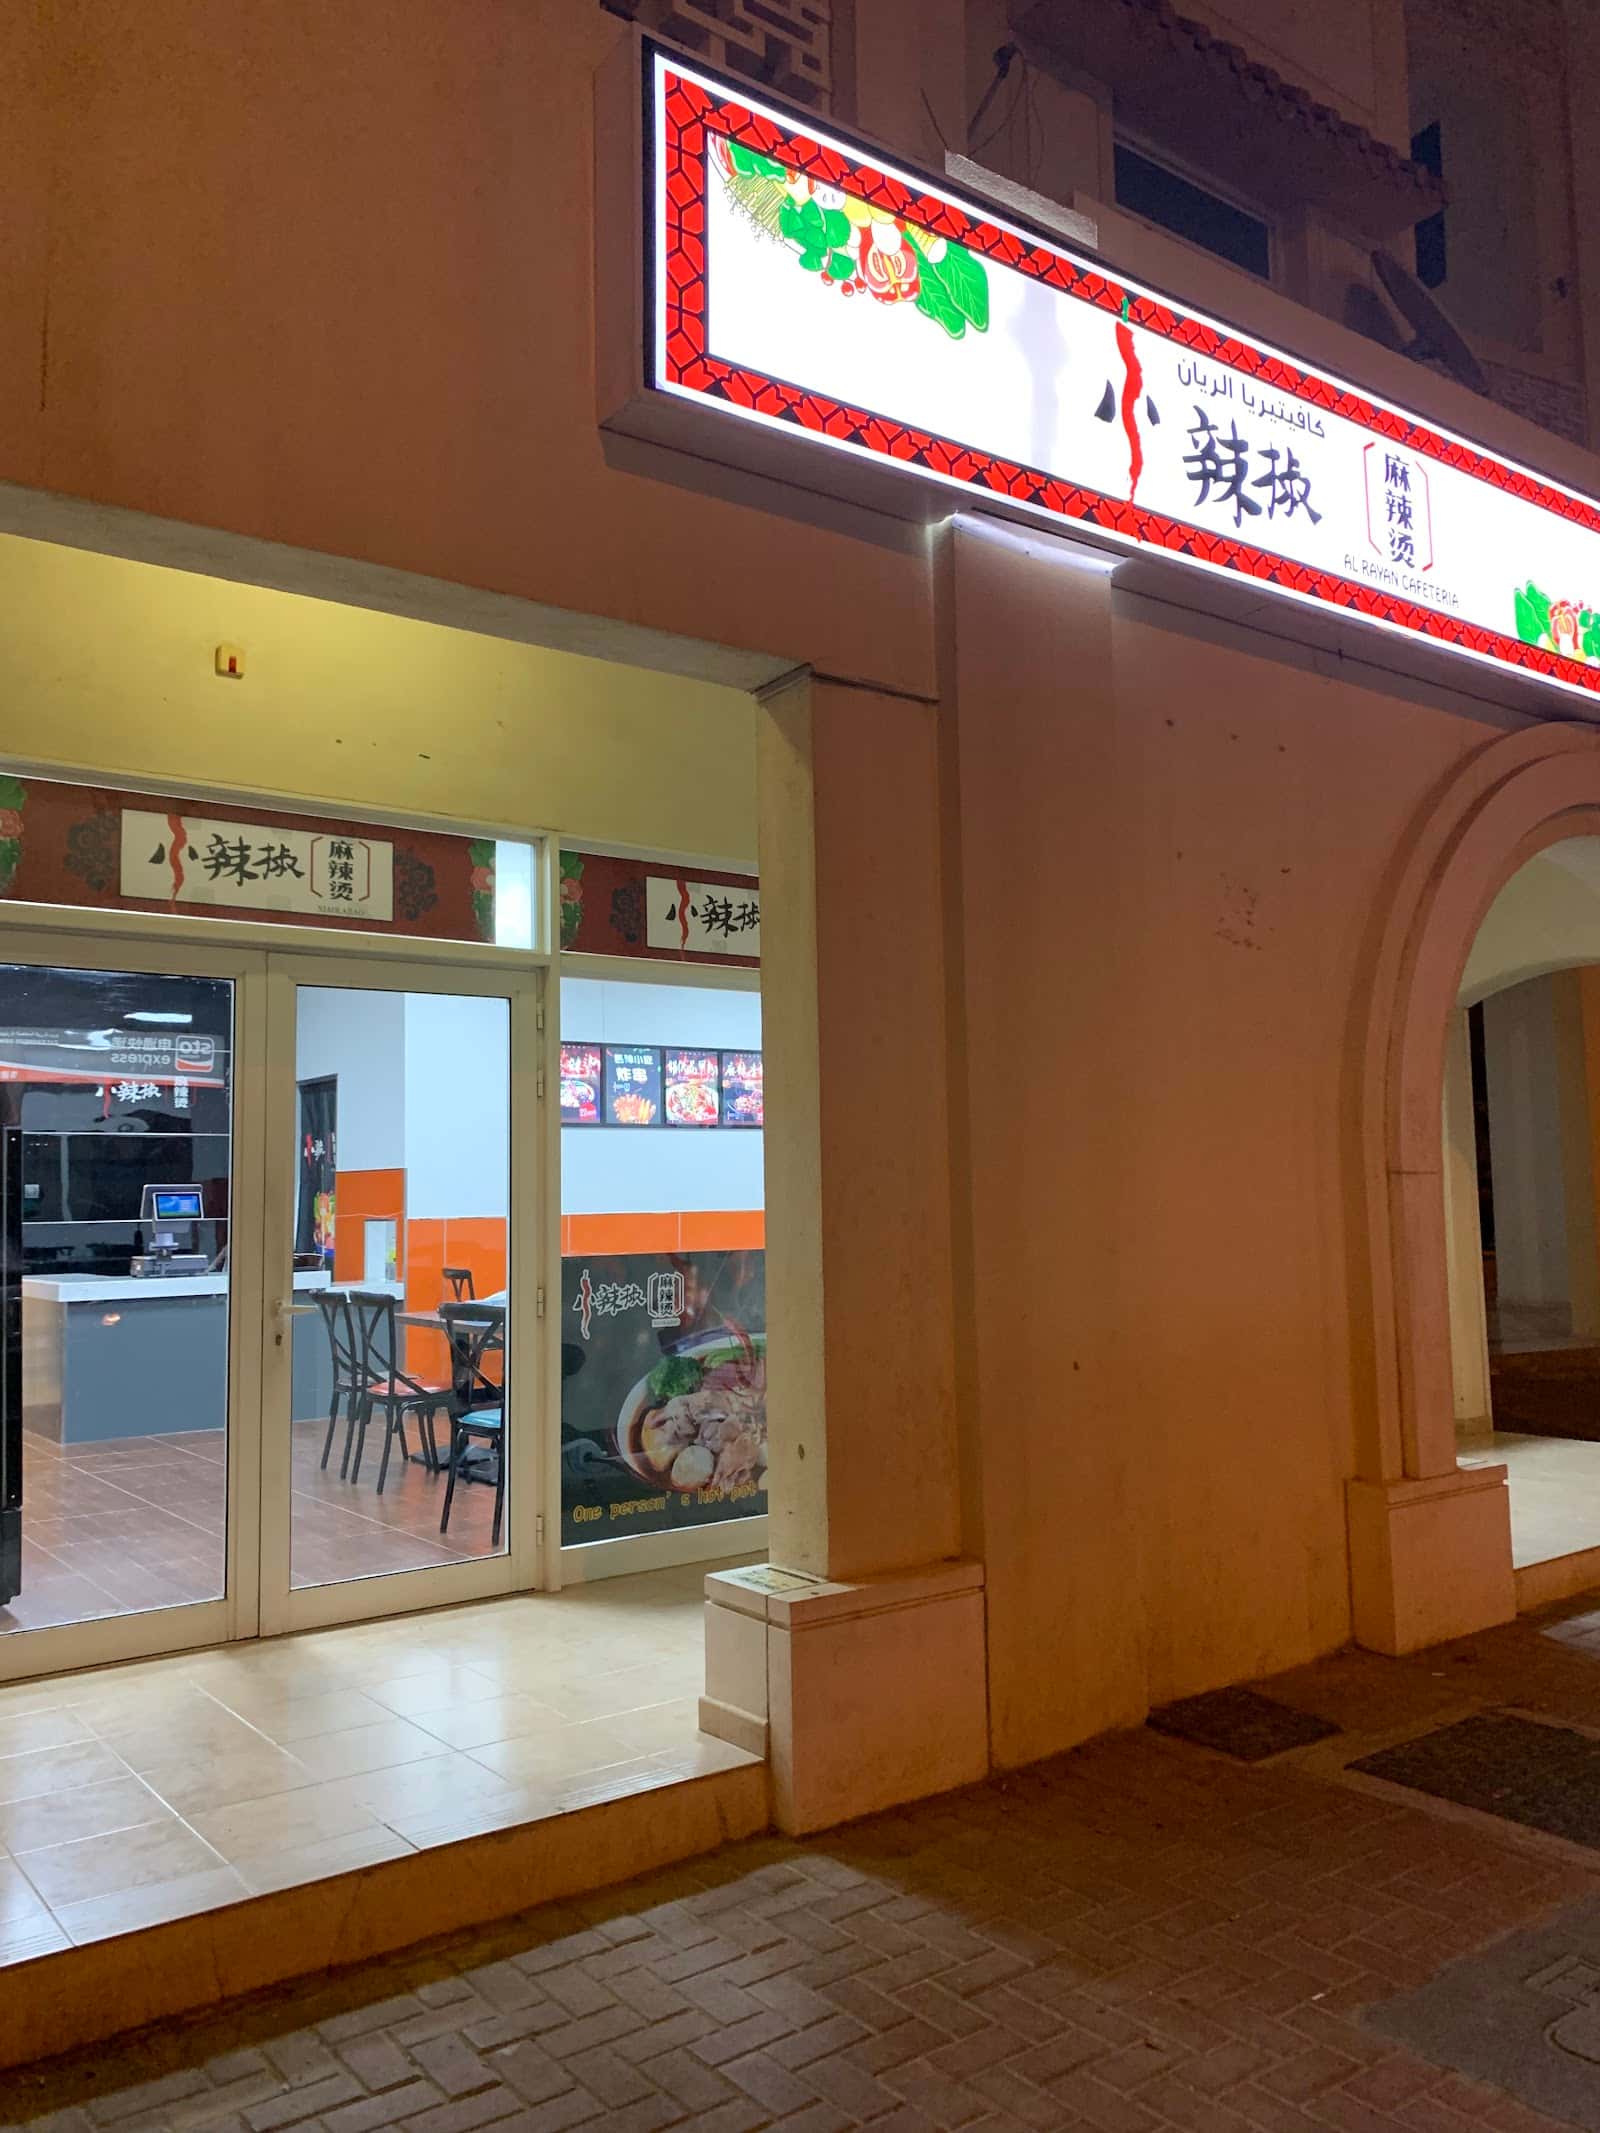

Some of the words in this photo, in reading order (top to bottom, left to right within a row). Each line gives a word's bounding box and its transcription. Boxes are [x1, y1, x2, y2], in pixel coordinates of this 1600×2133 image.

[1178, 358, 1233, 398] الريان
[1094, 318, 1322, 528] 小辣椒
[1242, 383, 1325, 438] كافيتيريا
[1384, 453, 1415, 568] 麻辣烫
[1344, 553, 1358, 573] AL
[1361, 559, 1399, 587] RAYAN
[1402, 574, 1459, 608] CAFETERIA
[149, 815, 305, 898] 小辣椒
[328, 839, 353, 901] 麻辣烫
[572, 1269, 647, 1333] 小辣椒
[573, 1504, 602, 1523] One
[697, 1486, 724, 1505] hot
[730, 1480, 757, 1502] pot
